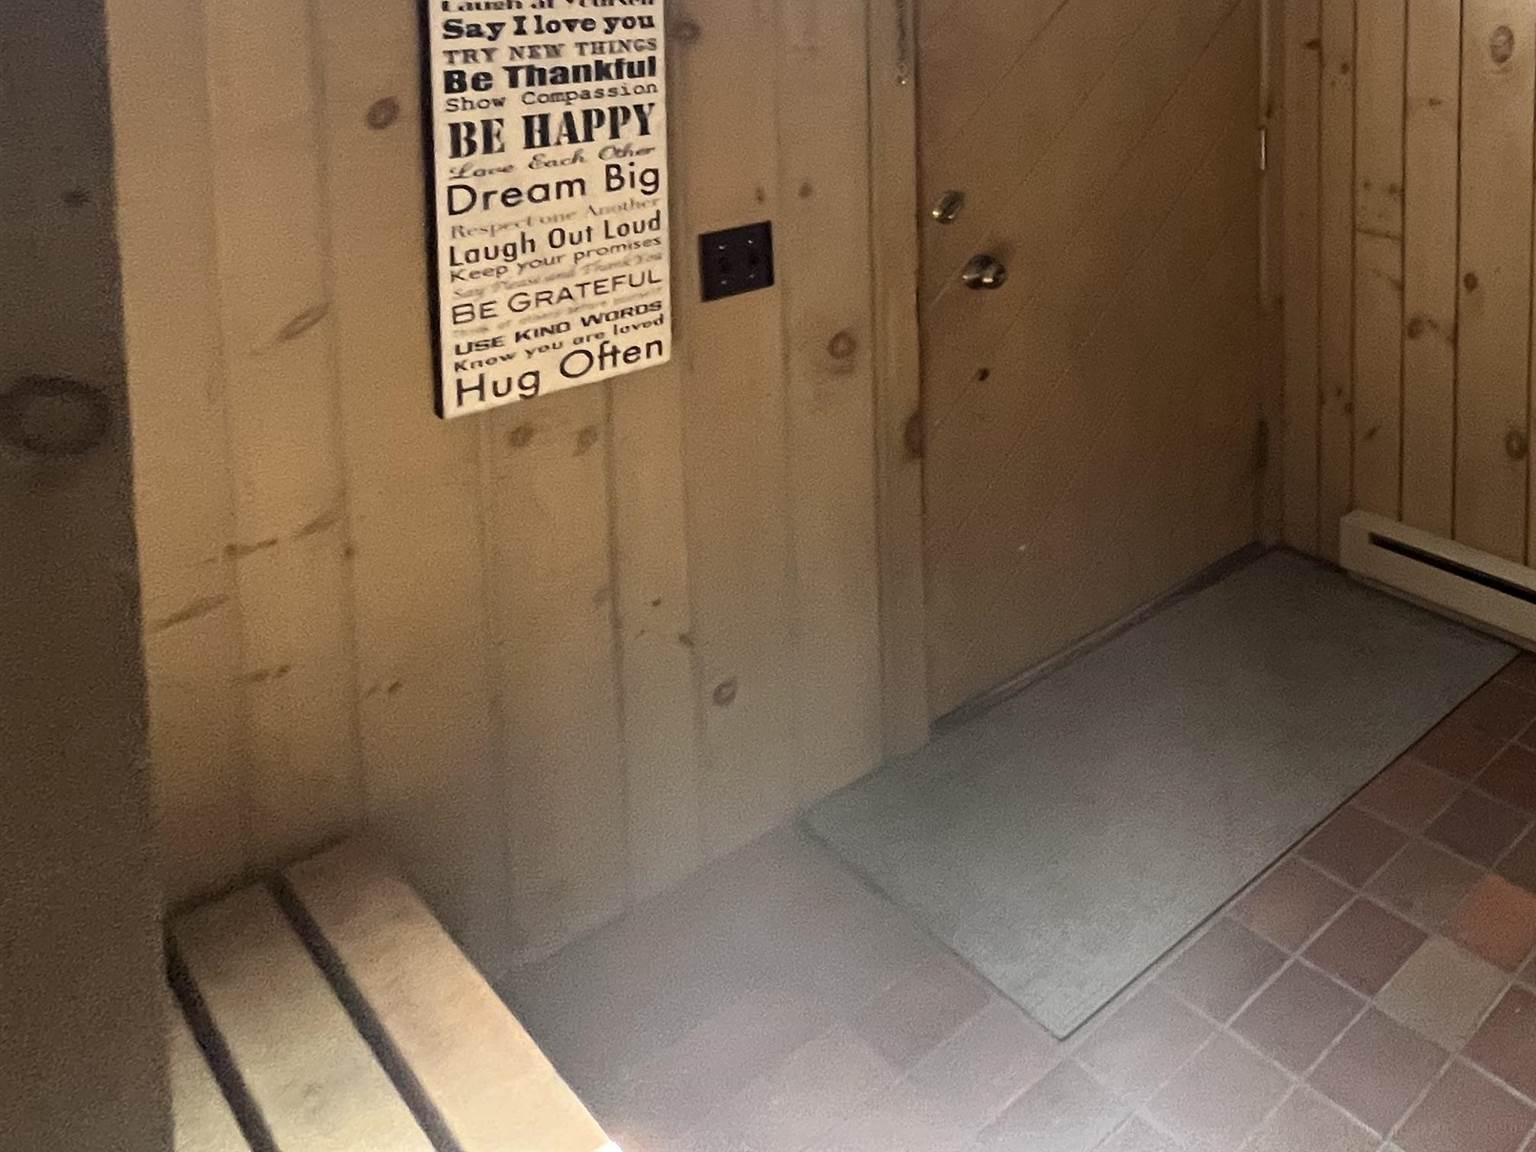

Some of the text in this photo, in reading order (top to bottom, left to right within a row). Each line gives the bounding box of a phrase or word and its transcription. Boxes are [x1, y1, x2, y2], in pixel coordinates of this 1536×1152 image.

[442, 15, 655, 41] Say I love you
[443, 38, 657, 65] TRY NEW THINGS
[443, 56, 657, 94] Be Thankful
[445, 83, 658, 113] Show Compassion
[448, 102, 656, 159] BE HAPPY
[449, 144, 657, 180] Love Each Other
[447, 162, 659, 216] Dream Big
[586, 197, 660, 218] Another
[449, 209, 661, 267] Laugh Out Loud
[450, 237, 661, 283] Keep your promises
[451, 300, 498, 325] BE
[508, 269, 662, 313] GRATEFUL
[454, 335, 506, 356] USE
[515, 322, 571, 344] KIND
[581, 300, 662, 328] WORDS
[454, 314, 665, 373] Know you are loved
[456, 338, 663, 407] Hug Often
